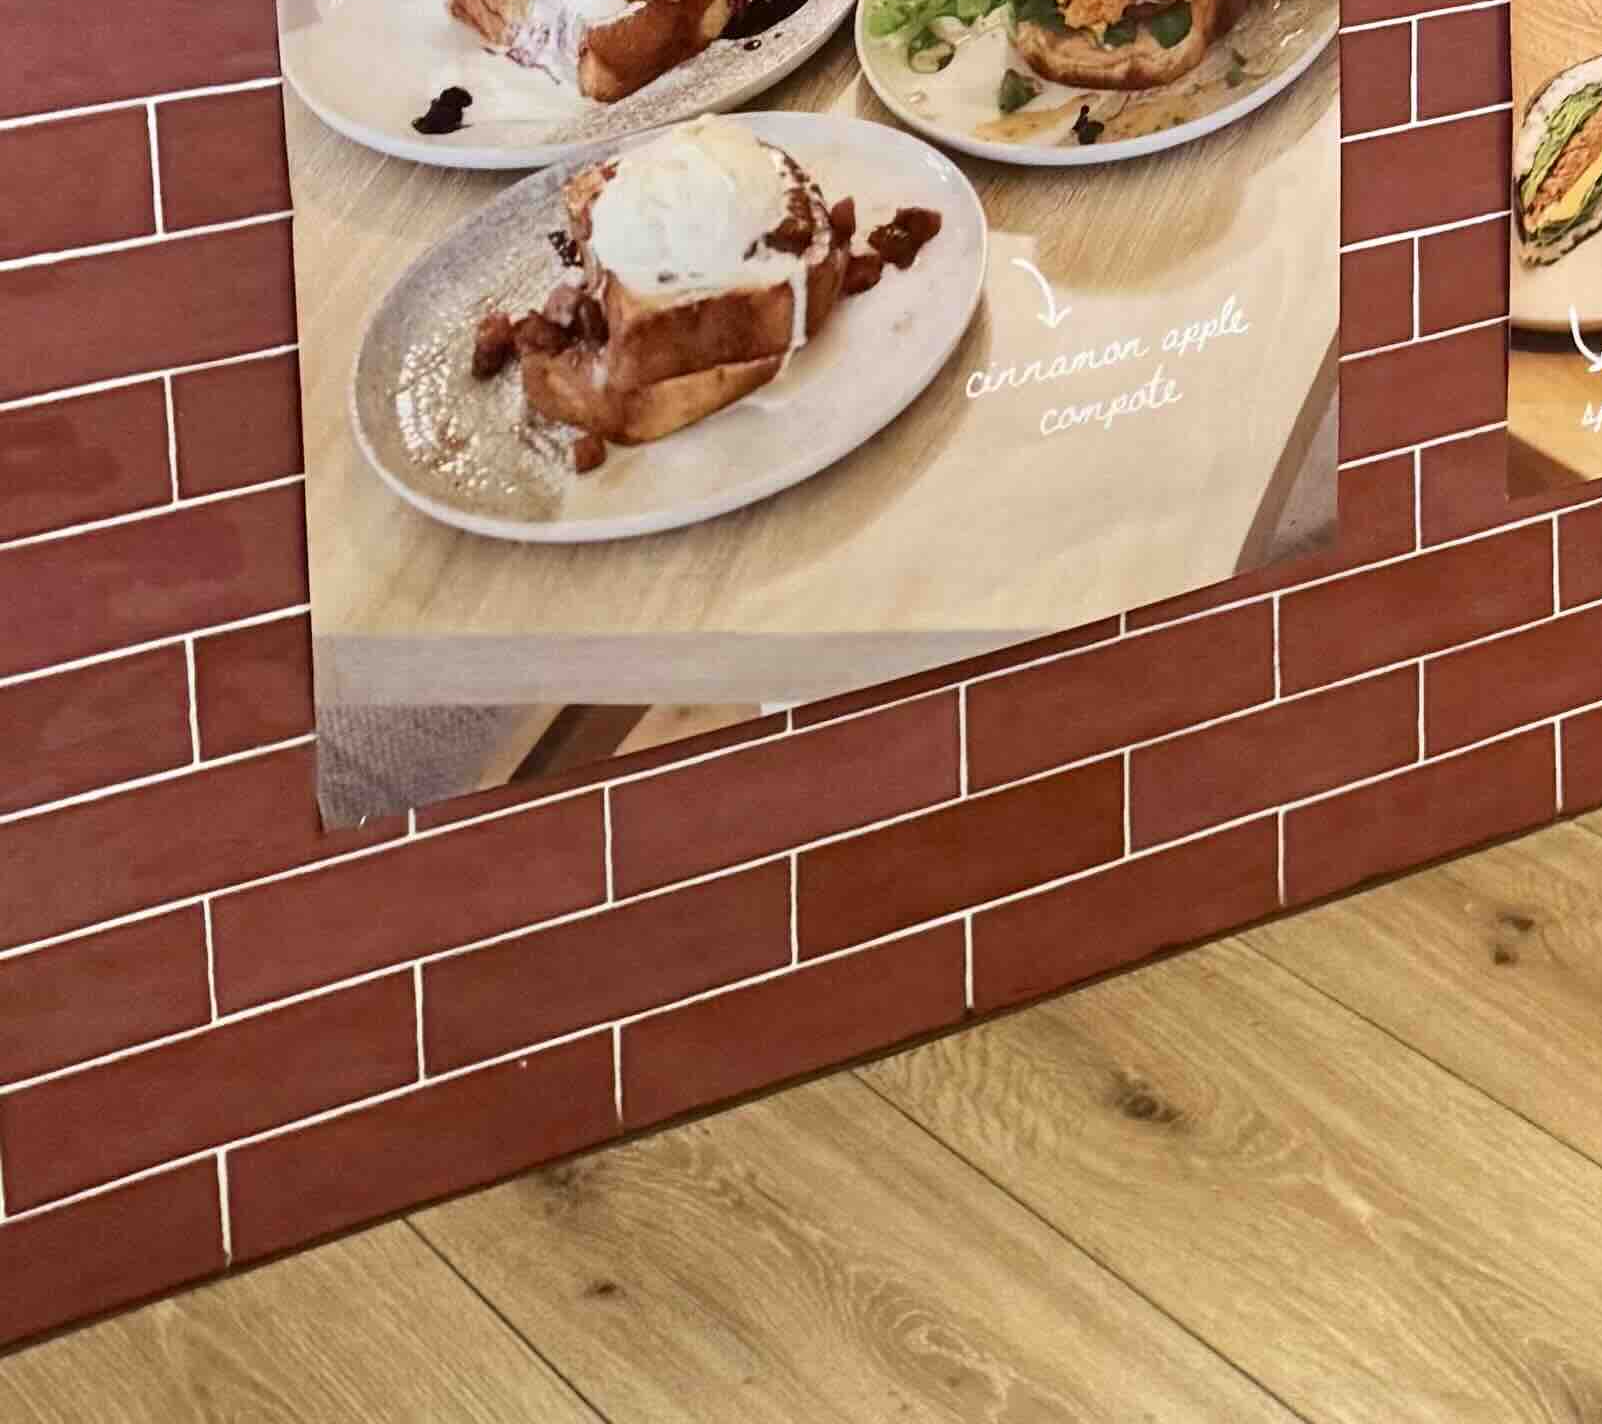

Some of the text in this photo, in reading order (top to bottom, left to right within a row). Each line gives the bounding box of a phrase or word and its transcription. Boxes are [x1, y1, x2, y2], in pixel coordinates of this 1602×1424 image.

[966, 294, 1250, 399] cinnamon apple
[1040, 364, 1184, 436] compote
